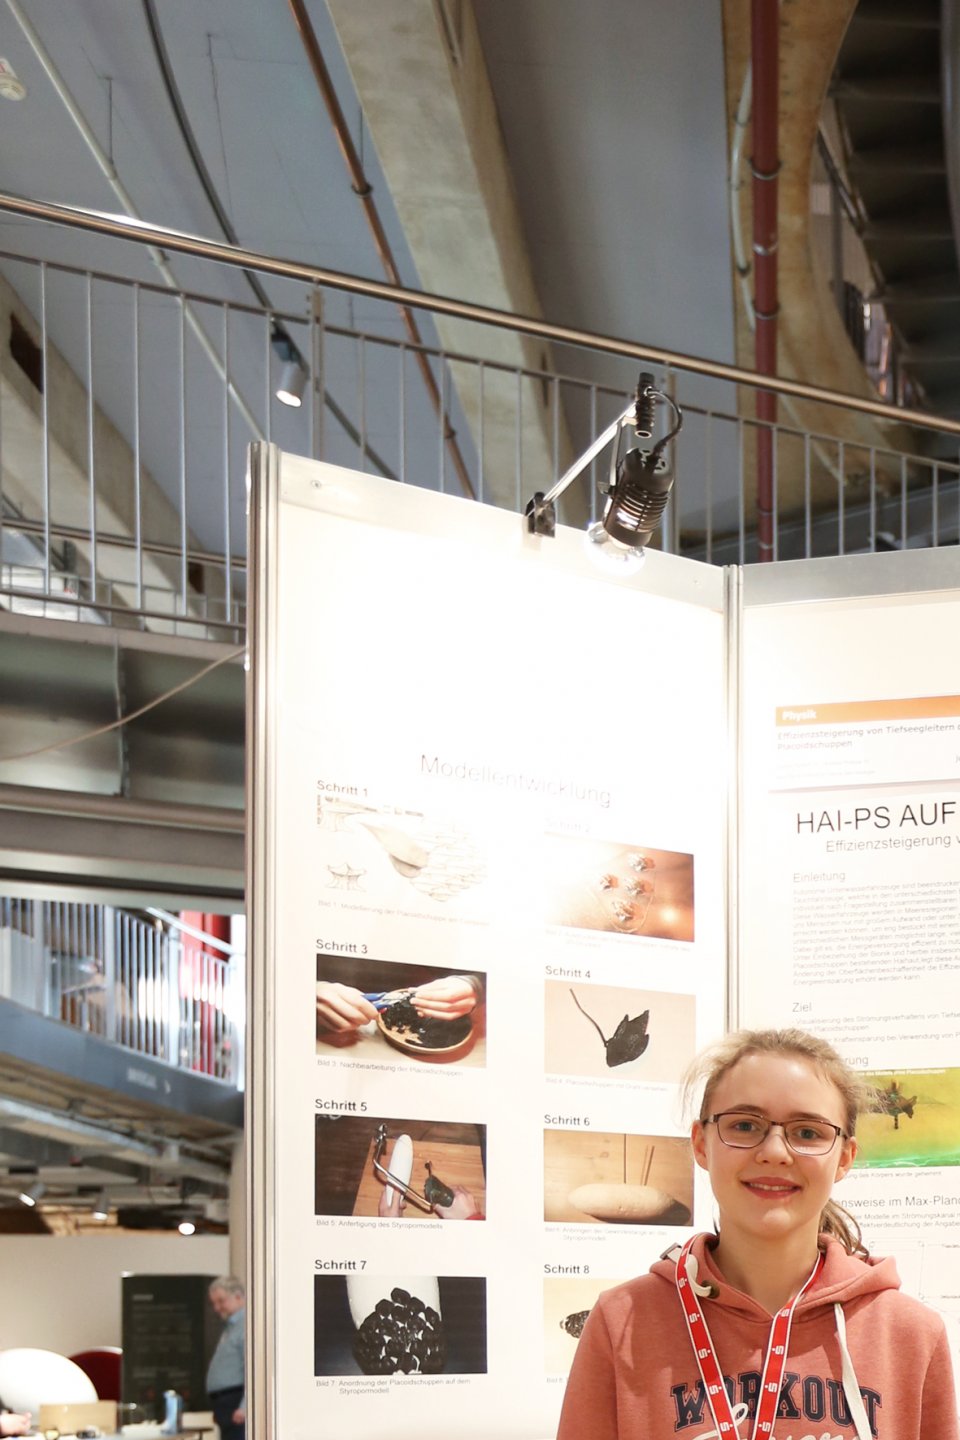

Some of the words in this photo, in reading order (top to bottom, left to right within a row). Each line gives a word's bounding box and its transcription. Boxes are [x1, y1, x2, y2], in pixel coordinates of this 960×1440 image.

[782, 709, 816, 721] Physik
[777, 727, 864, 741] Effizienzsteigerung
[866, 726, 883, 734] von
[886, 723, 955, 735] Tiefseegleitern
[777, 740, 852, 751] Placoidschuppen
[420, 753, 611, 809] Modellentwicklung
[316, 779, 358, 797] Schritt
[363, 787, 369, 797] 1
[796, 805, 891, 834] HAI-PS
[900, 801, 957, 828] AUF
[826, 836, 950, 852] Effizienzsteigerung
[793, 871, 846, 883] Einleitung
[316, 938, 357, 955] Schritt
[362, 944, 368, 954] 3
[545, 965, 581, 978] Schritt
[585, 970, 591, 978] 4
[792, 1002, 812, 1013] Ziel
[314, 1098, 357, 1112] Schritt
[360, 1101, 367, 1112] 5
[544, 1114, 580, 1126] Schritt
[583, 1117, 590, 1126] 6
[889, 1198, 902, 1207] im
[338, 1220, 376, 1228] Anfertigung
[314, 1259, 356, 1270] Schritt
[360, 1260, 367, 1270] 7
[544, 1264, 580, 1274] Schritt
[583, 1264, 590, 1274] 8
